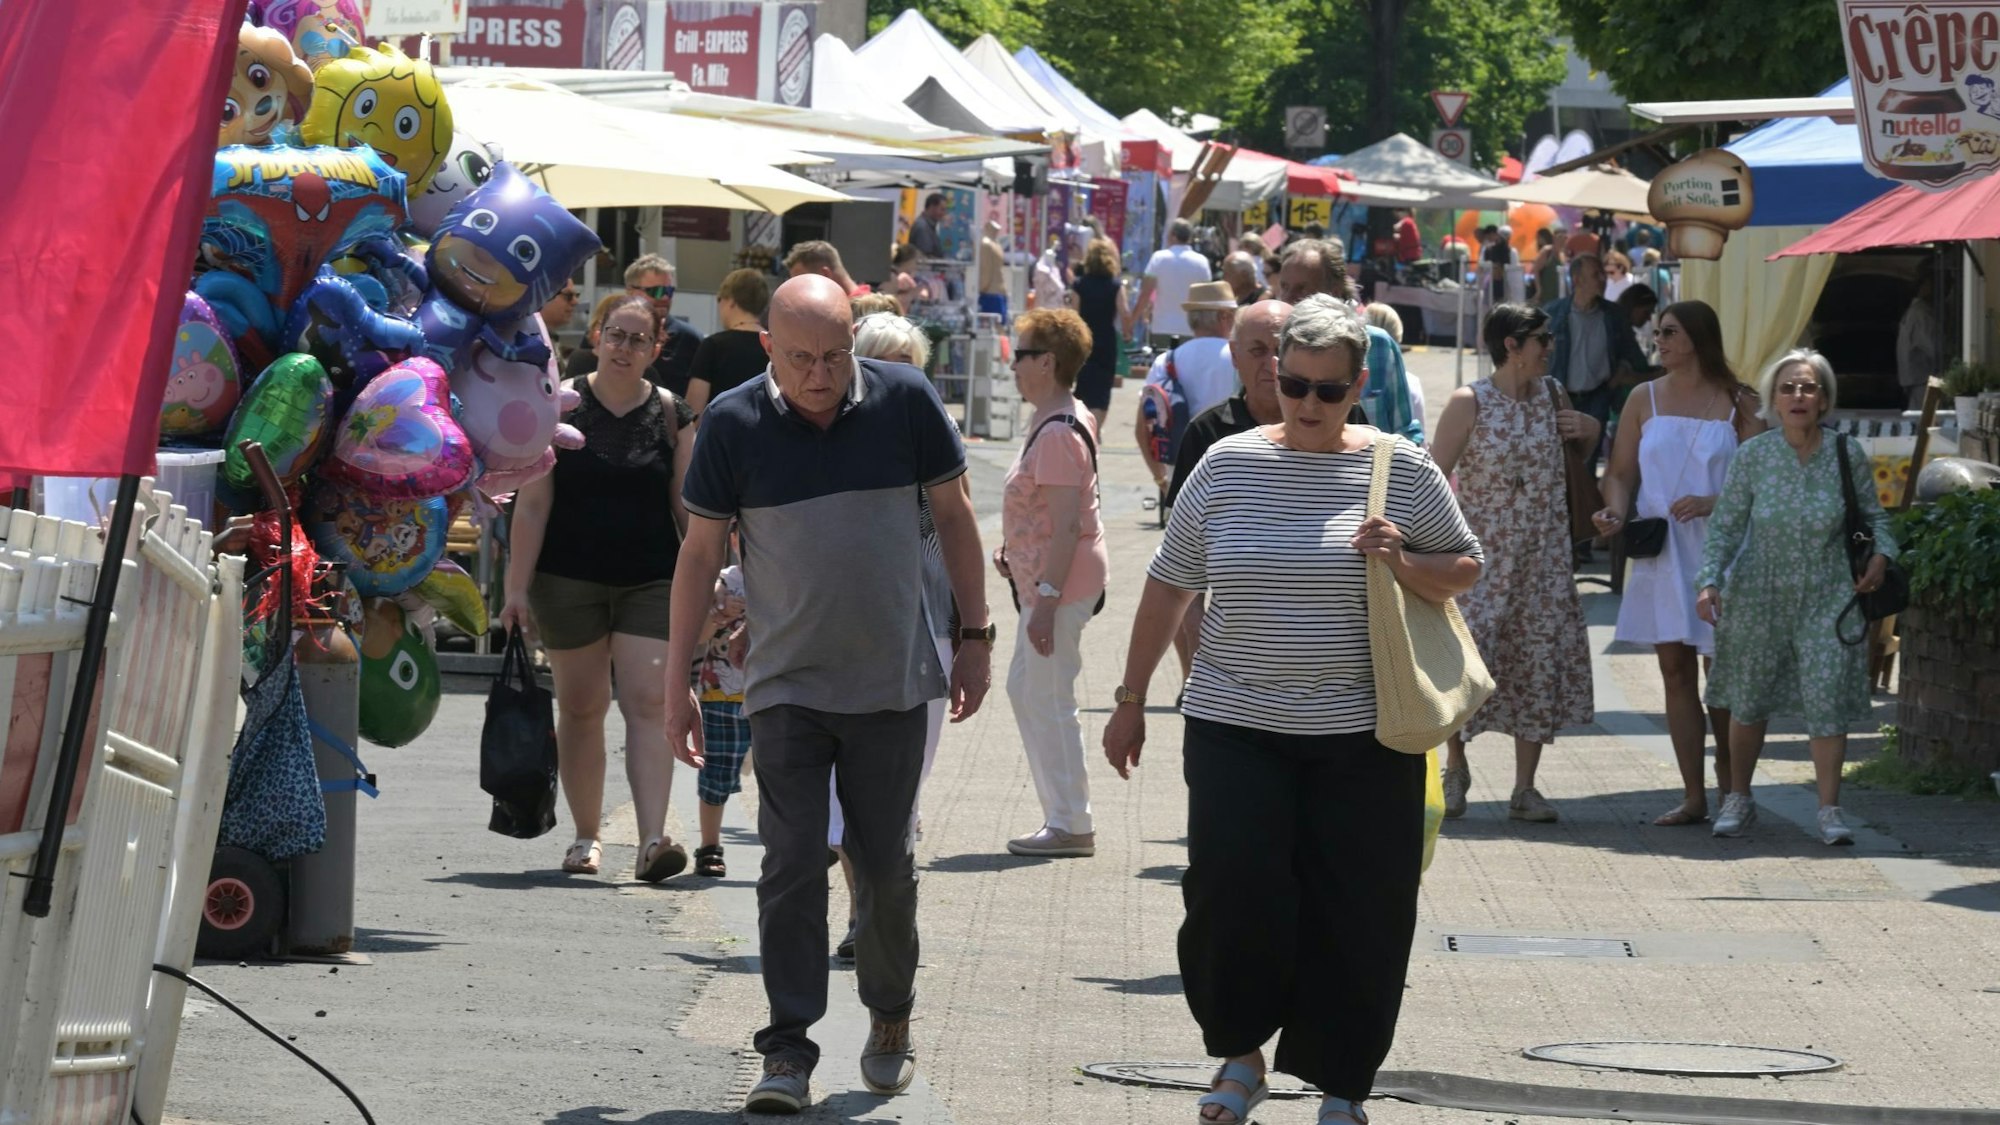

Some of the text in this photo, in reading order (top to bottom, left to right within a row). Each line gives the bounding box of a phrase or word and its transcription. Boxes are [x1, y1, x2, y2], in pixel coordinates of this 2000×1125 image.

[675, 30, 698, 54] Grill
[705, 30, 748, 54] EXPRESS
[1881, 114, 1961, 136] nutella
[1664, 177, 1712, 195] Portion
[1686, 192, 1720, 207] Soße
